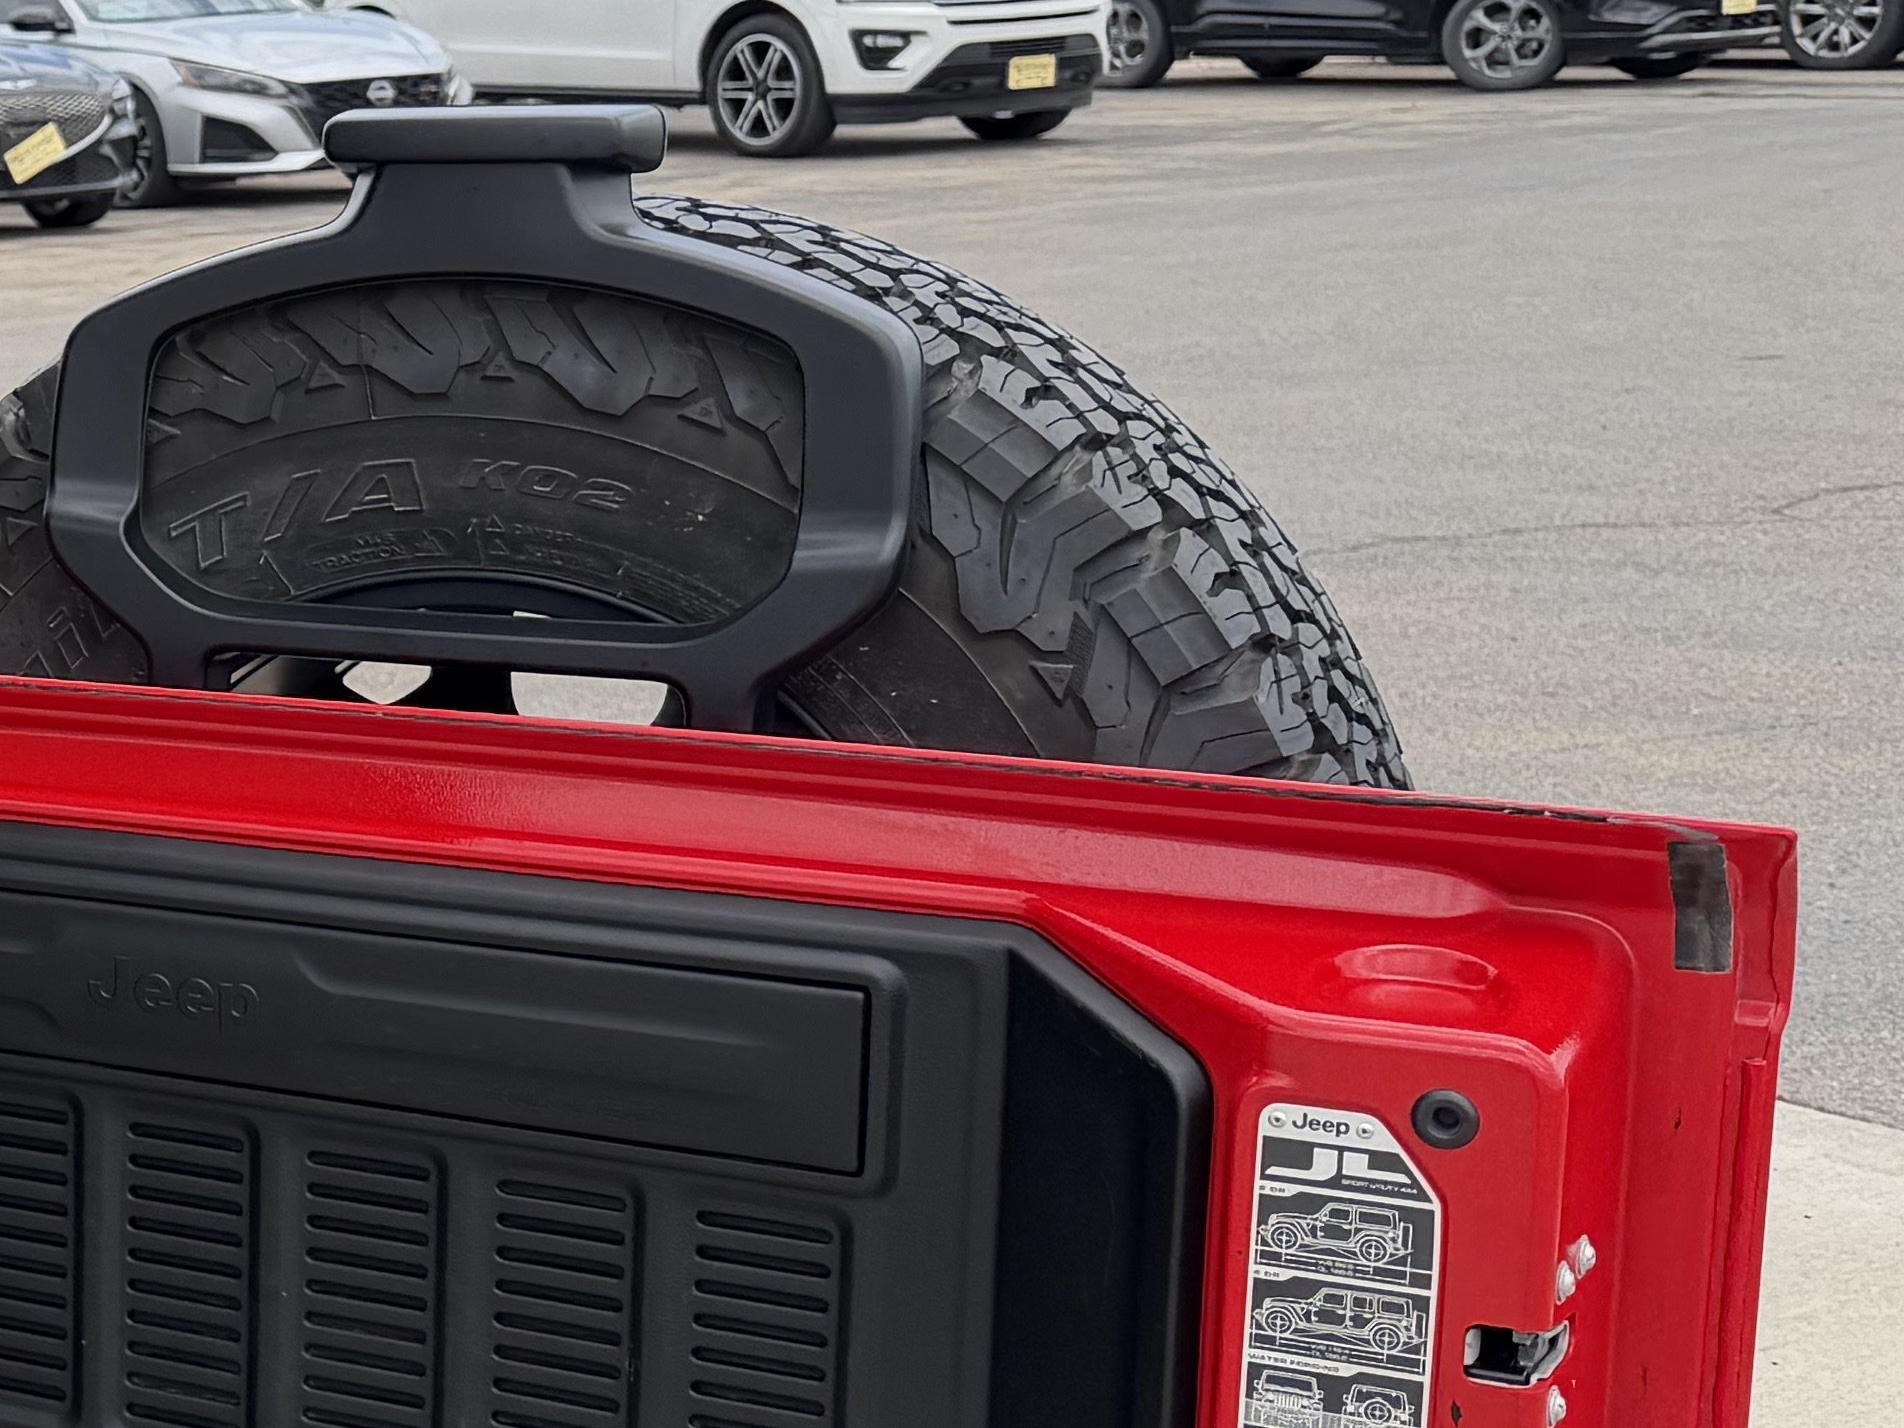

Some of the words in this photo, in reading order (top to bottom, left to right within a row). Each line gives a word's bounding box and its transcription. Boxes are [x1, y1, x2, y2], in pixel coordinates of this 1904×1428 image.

[167, 458, 428, 570] T/A
[458, 458, 634, 513] KO2
[310, 543, 408, 572] TRACTION
[87, 955, 259, 1033] Jeep
[1292, 1112, 1350, 1138] Jeep
[1264, 1147, 1412, 1184] JL
[1248, 1352, 1288, 1365] WATER
